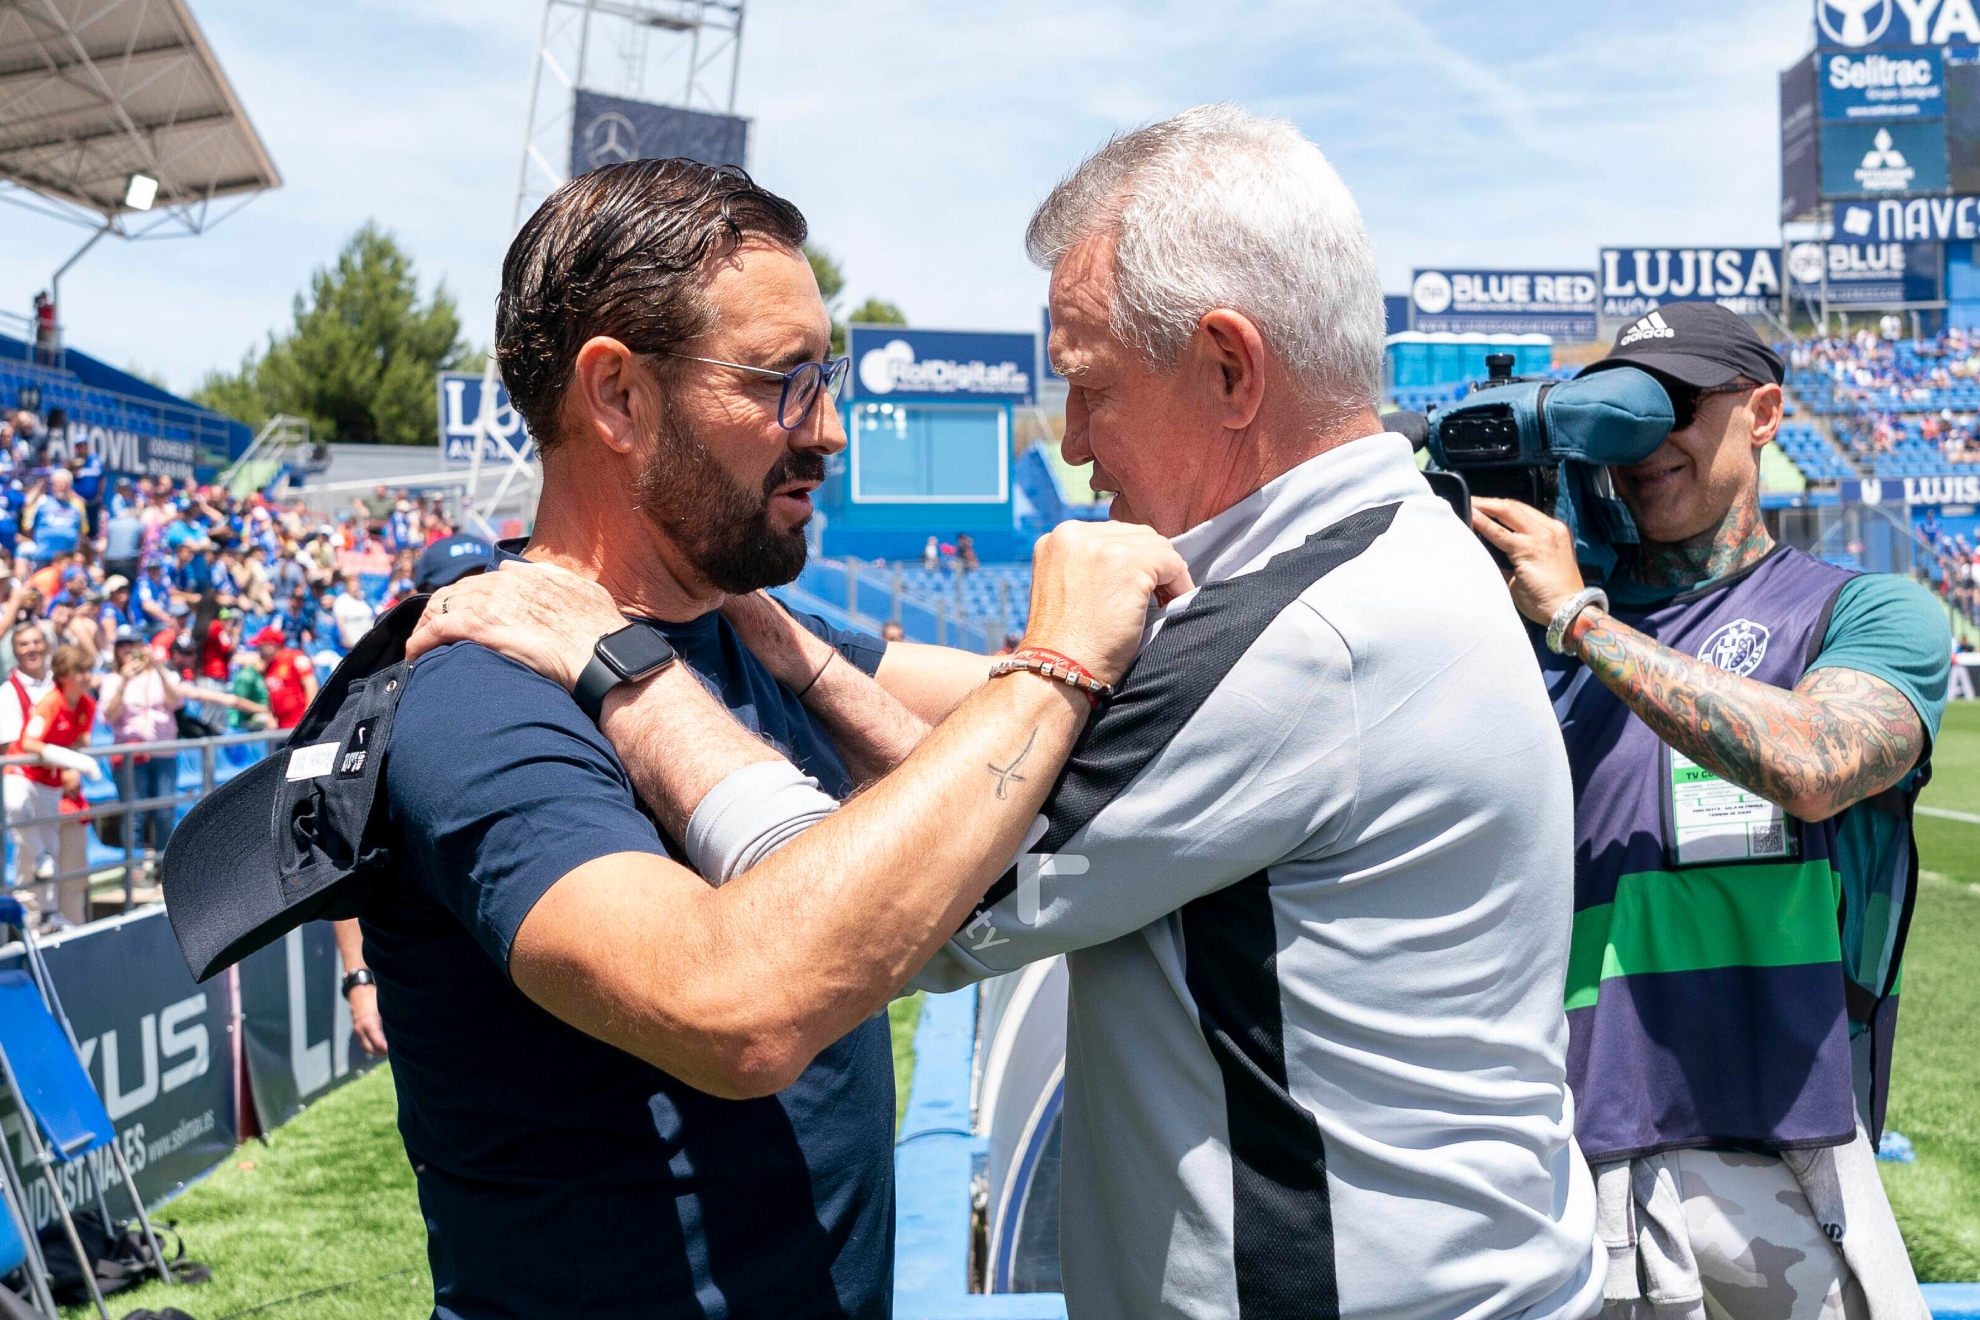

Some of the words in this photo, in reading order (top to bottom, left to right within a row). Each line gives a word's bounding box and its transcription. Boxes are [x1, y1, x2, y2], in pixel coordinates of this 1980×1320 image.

[1828, 243, 1906, 271] BLUE
[1602, 250, 1780, 297] LUJISA
[1452, 275, 1531, 302] BLUE
[1534, 275, 1596, 302] RED
[1621, 328, 1675, 346] adidas
[1686, 771, 1699, 780] TV
